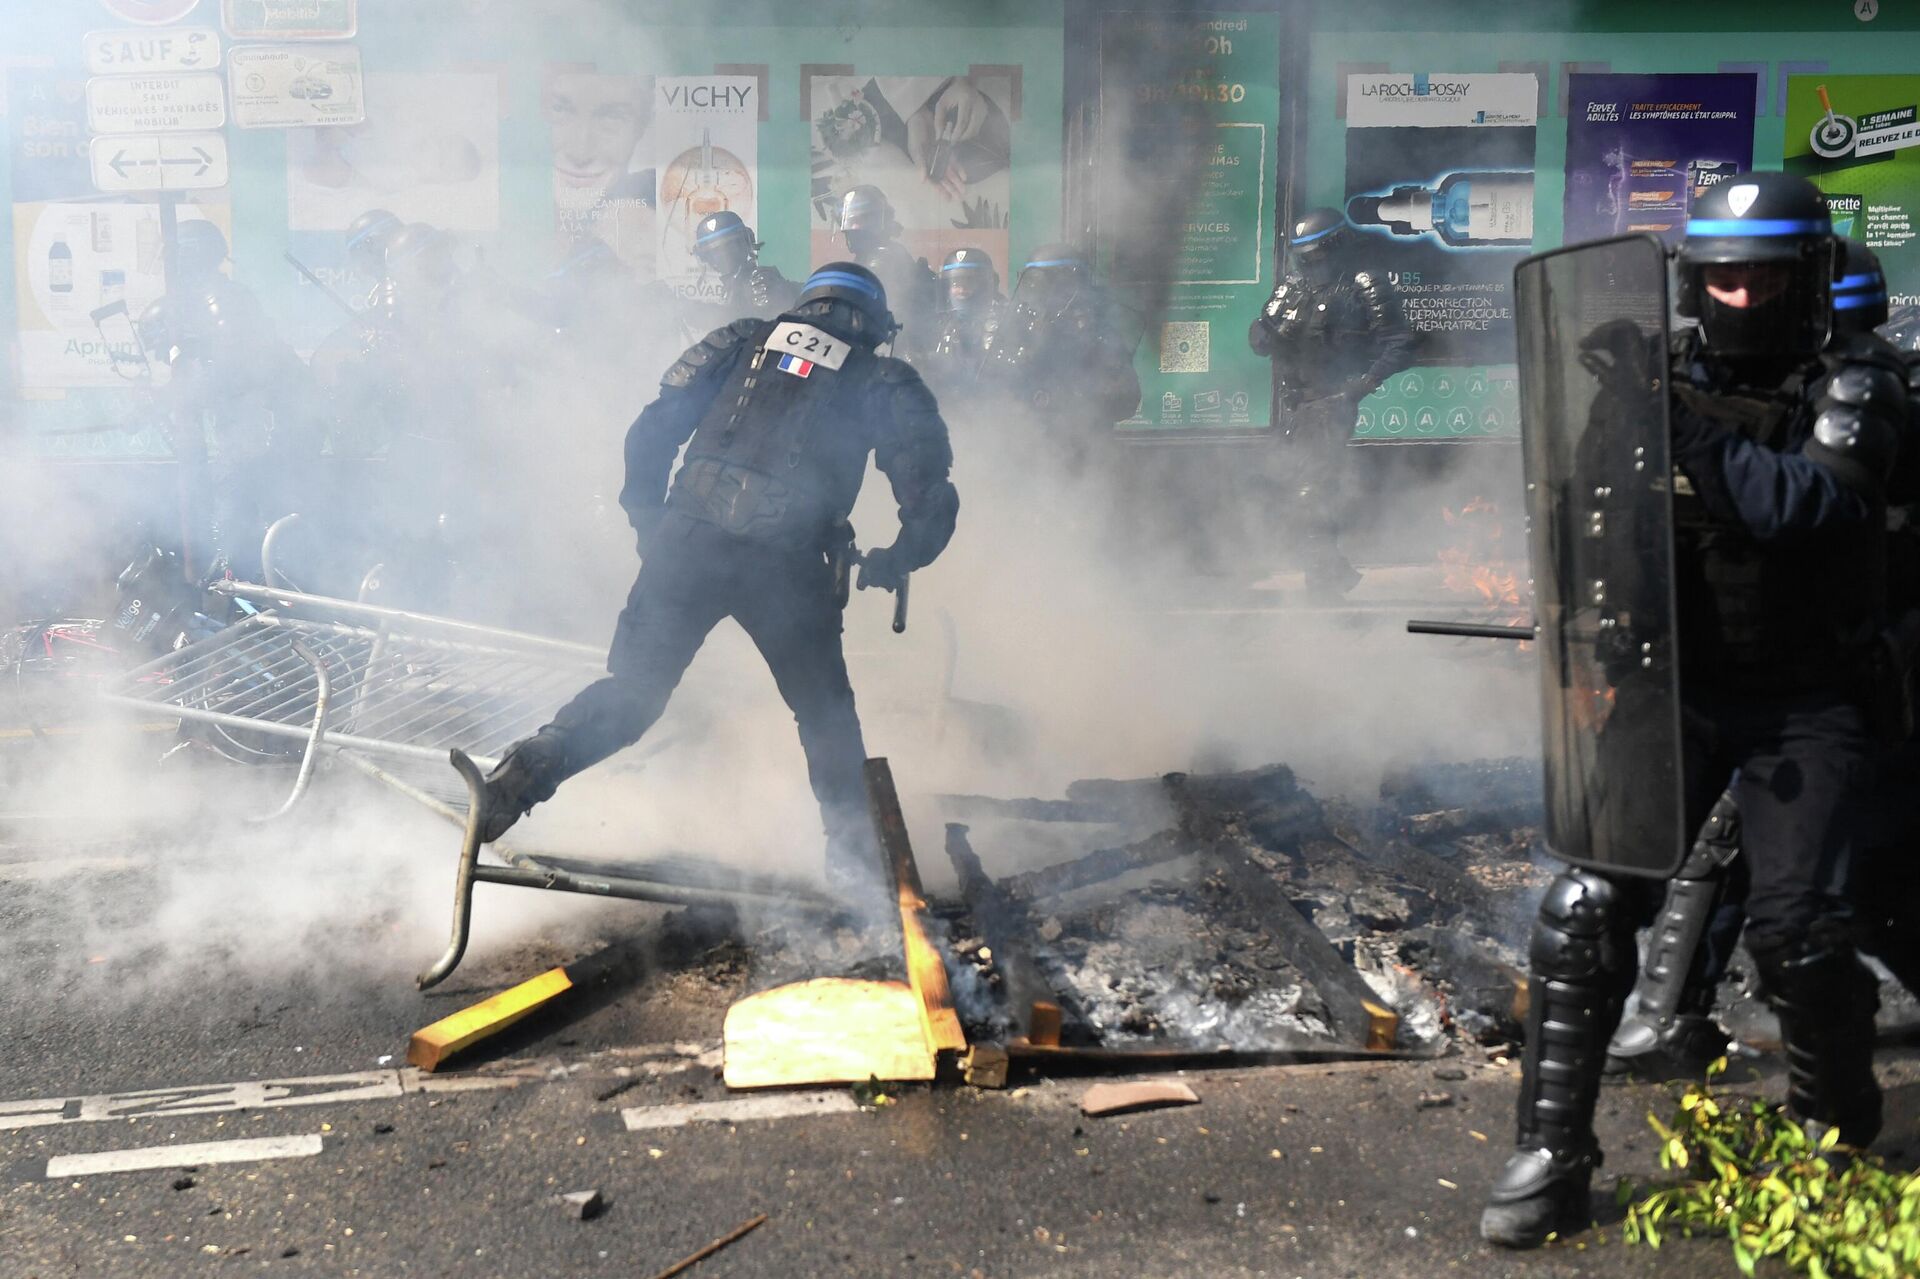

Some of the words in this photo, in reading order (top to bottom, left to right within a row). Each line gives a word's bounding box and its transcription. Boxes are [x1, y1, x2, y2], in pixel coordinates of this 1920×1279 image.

[99, 39, 173, 64] SAUF
[130, 81, 180, 90] INTERDIT
[1362, 84, 1378, 96] LA
[143, 93, 170, 102] SAUF
[661, 85, 752, 108] VICHY
[1587, 102, 1616, 113] FERVEX
[1586, 113, 1619, 122] ADULTES
[1629, 111, 1641, 119] LES
[1642, 110, 1679, 119] SYMPTÔMES
[1862, 118, 1866, 126] 1
[1870, 109, 1913, 125] SEMAINE
[1859, 133, 1900, 148] RELEVEZ
[1902, 130, 1913, 140] LE
[1826, 198, 1860, 210] orette
[1183, 223, 1231, 232] ERVICES
[1402, 272, 1421, 284] B5
[1421, 298, 1492, 308] CORRECTION
[787, 331, 802, 345] C
[804, 337, 833, 357] 21
